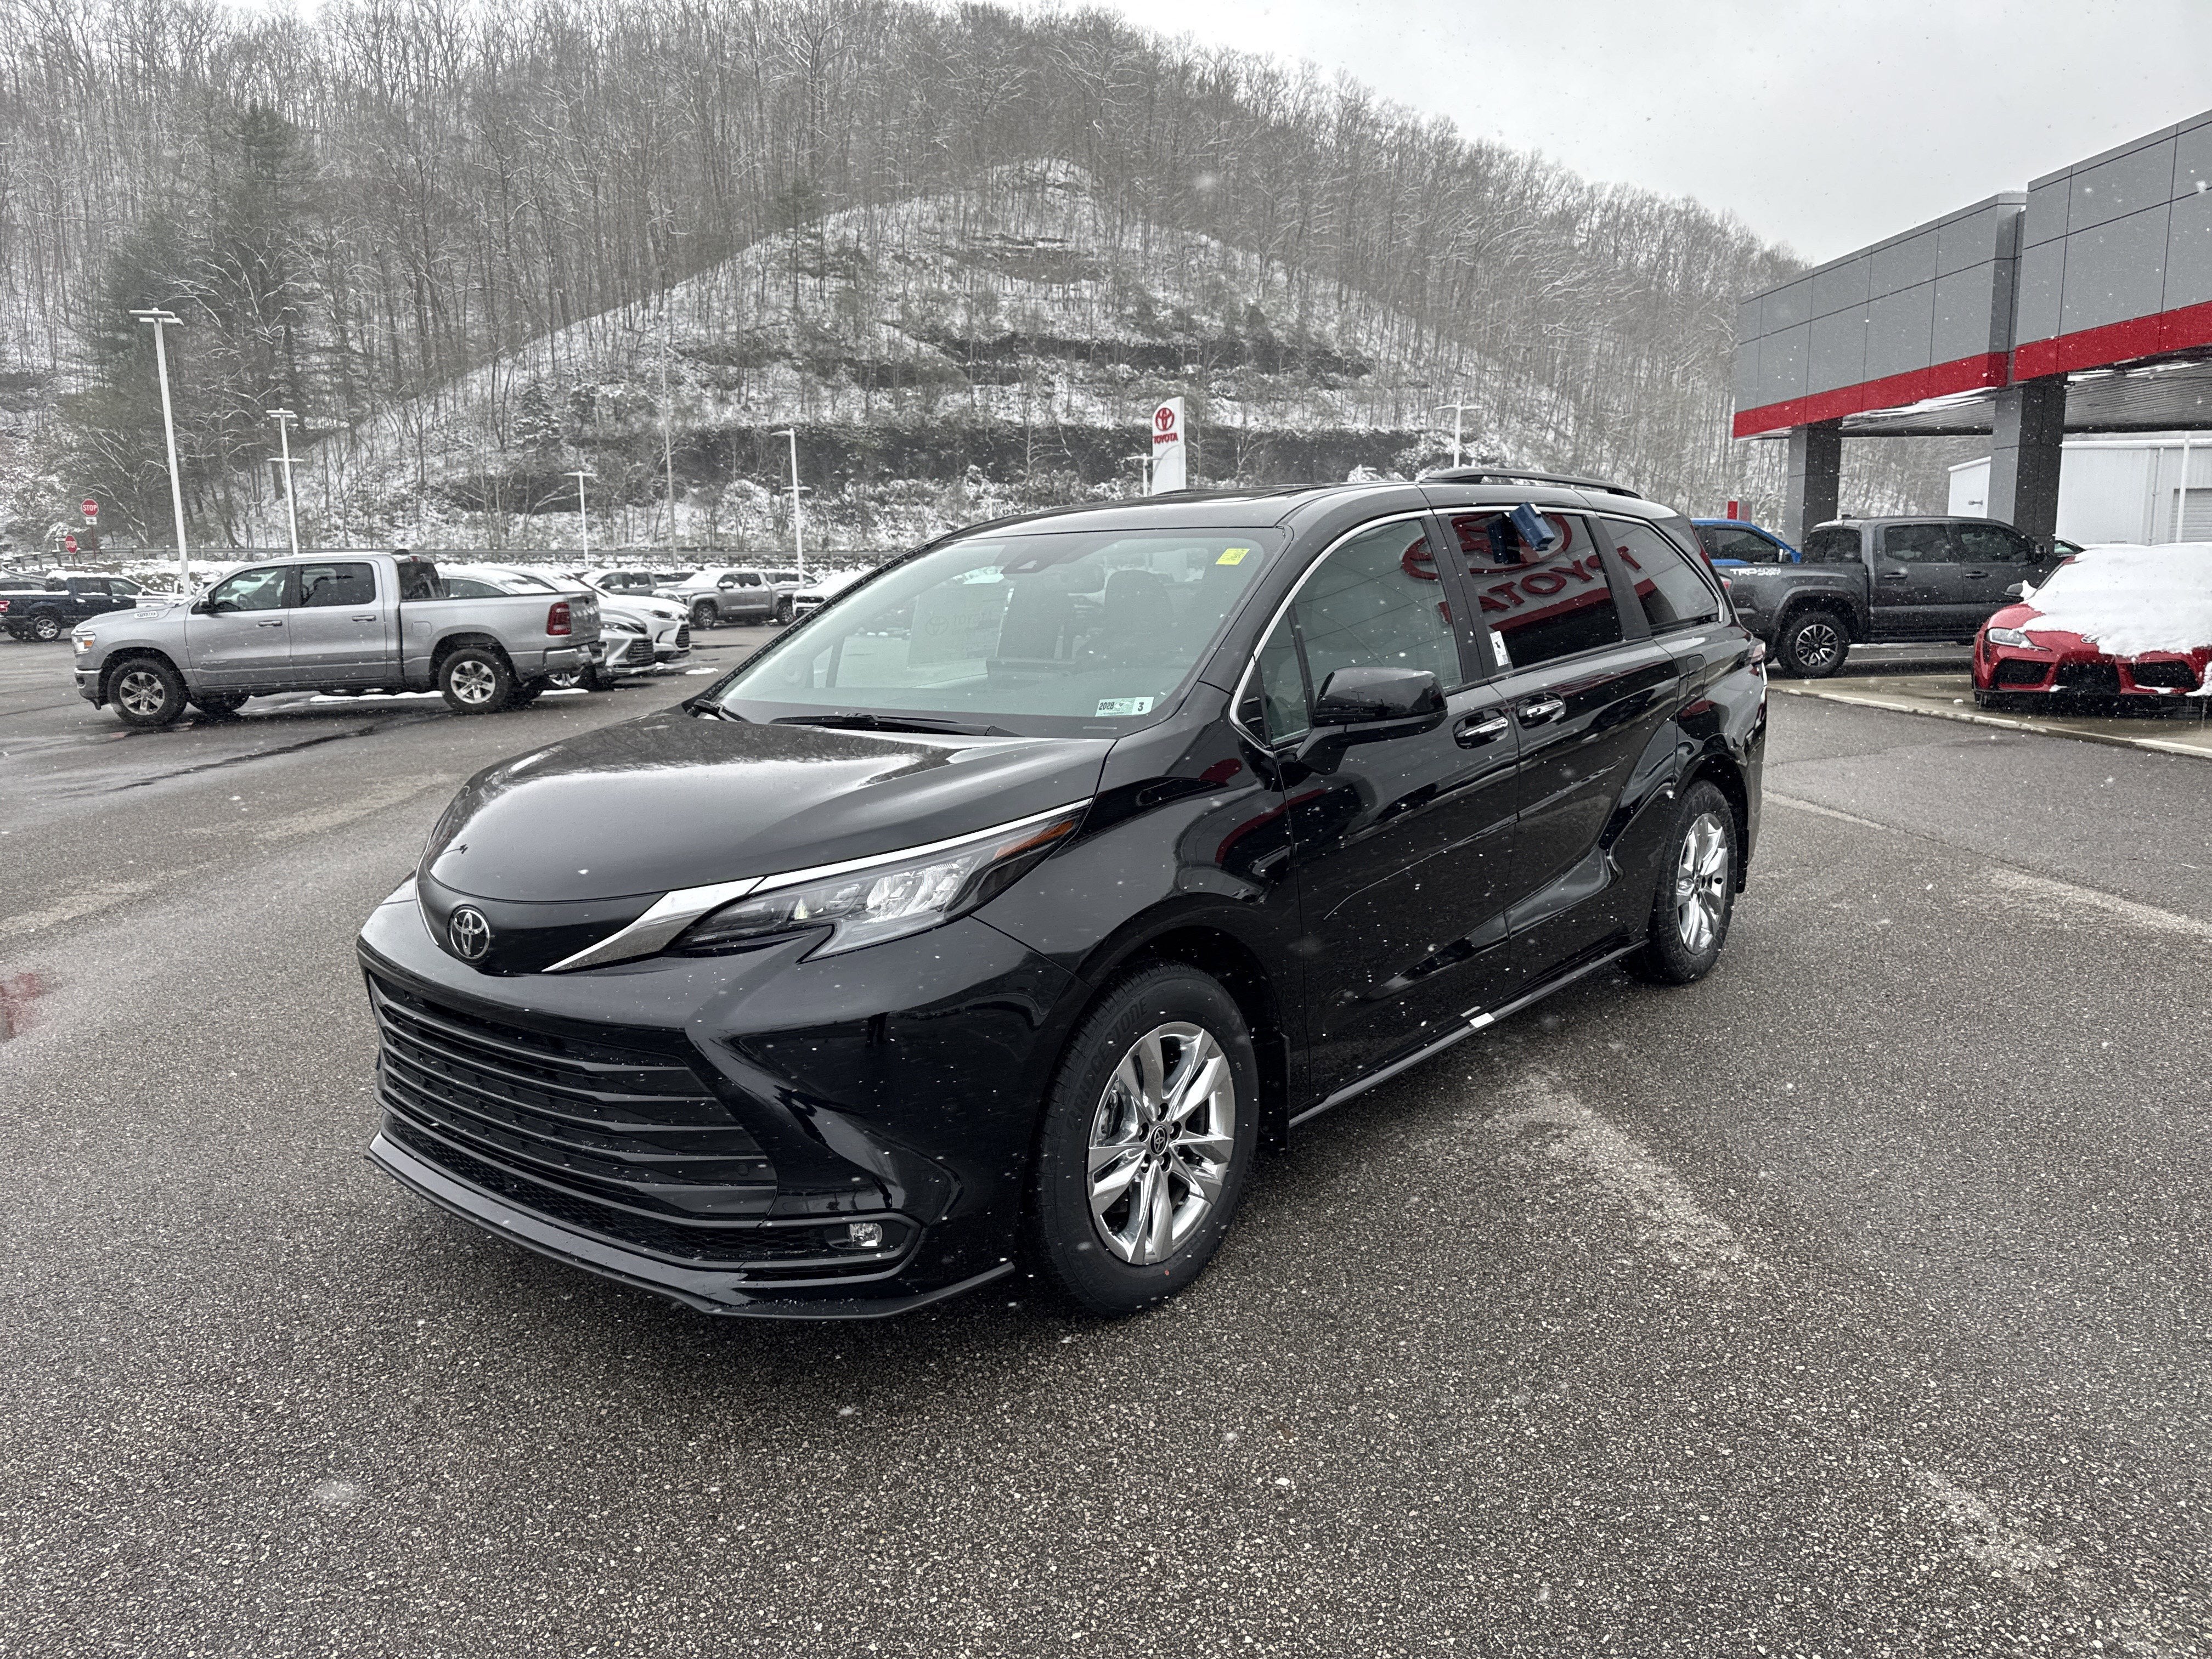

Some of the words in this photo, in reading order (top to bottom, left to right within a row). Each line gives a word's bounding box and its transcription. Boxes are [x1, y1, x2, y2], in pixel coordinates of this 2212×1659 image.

[1153, 432, 1178, 444] TOYOTA
[66, 540, 77, 549] STOP
[1729, 568, 1757, 576] TRD
[1098, 701, 1115, 710] 2028
[1137, 702, 1144, 712] 3
[1065, 996, 1148, 1133] BRIDGESTONE
